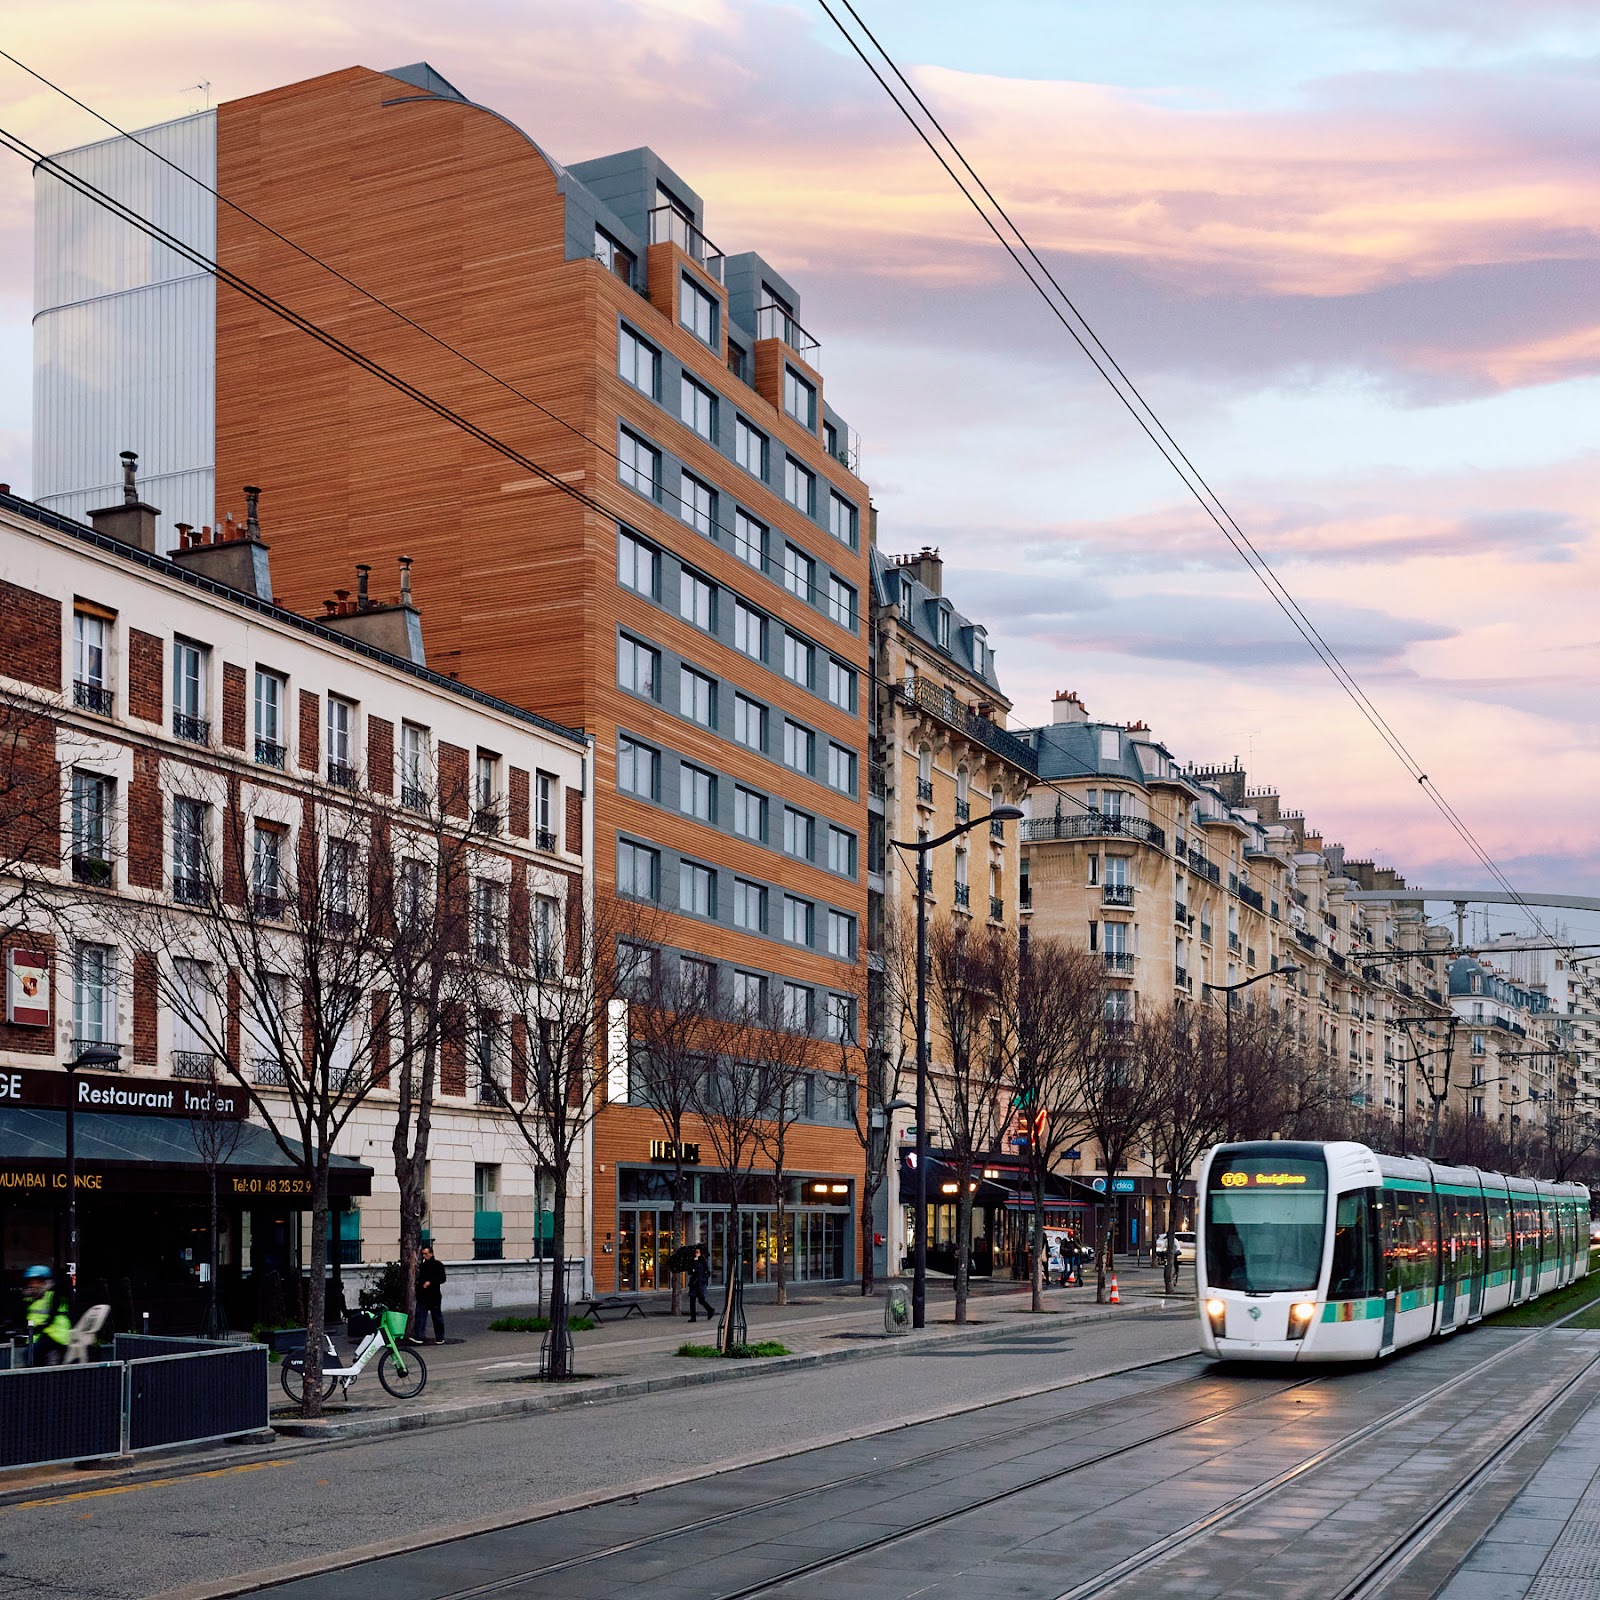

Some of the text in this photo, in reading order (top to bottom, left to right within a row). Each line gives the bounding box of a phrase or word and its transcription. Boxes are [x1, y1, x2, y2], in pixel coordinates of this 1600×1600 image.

[78, 1081, 235, 1112] Restaurant Inden
[232, 1178, 313, 1193] Tél: 01 48 28 52 9
